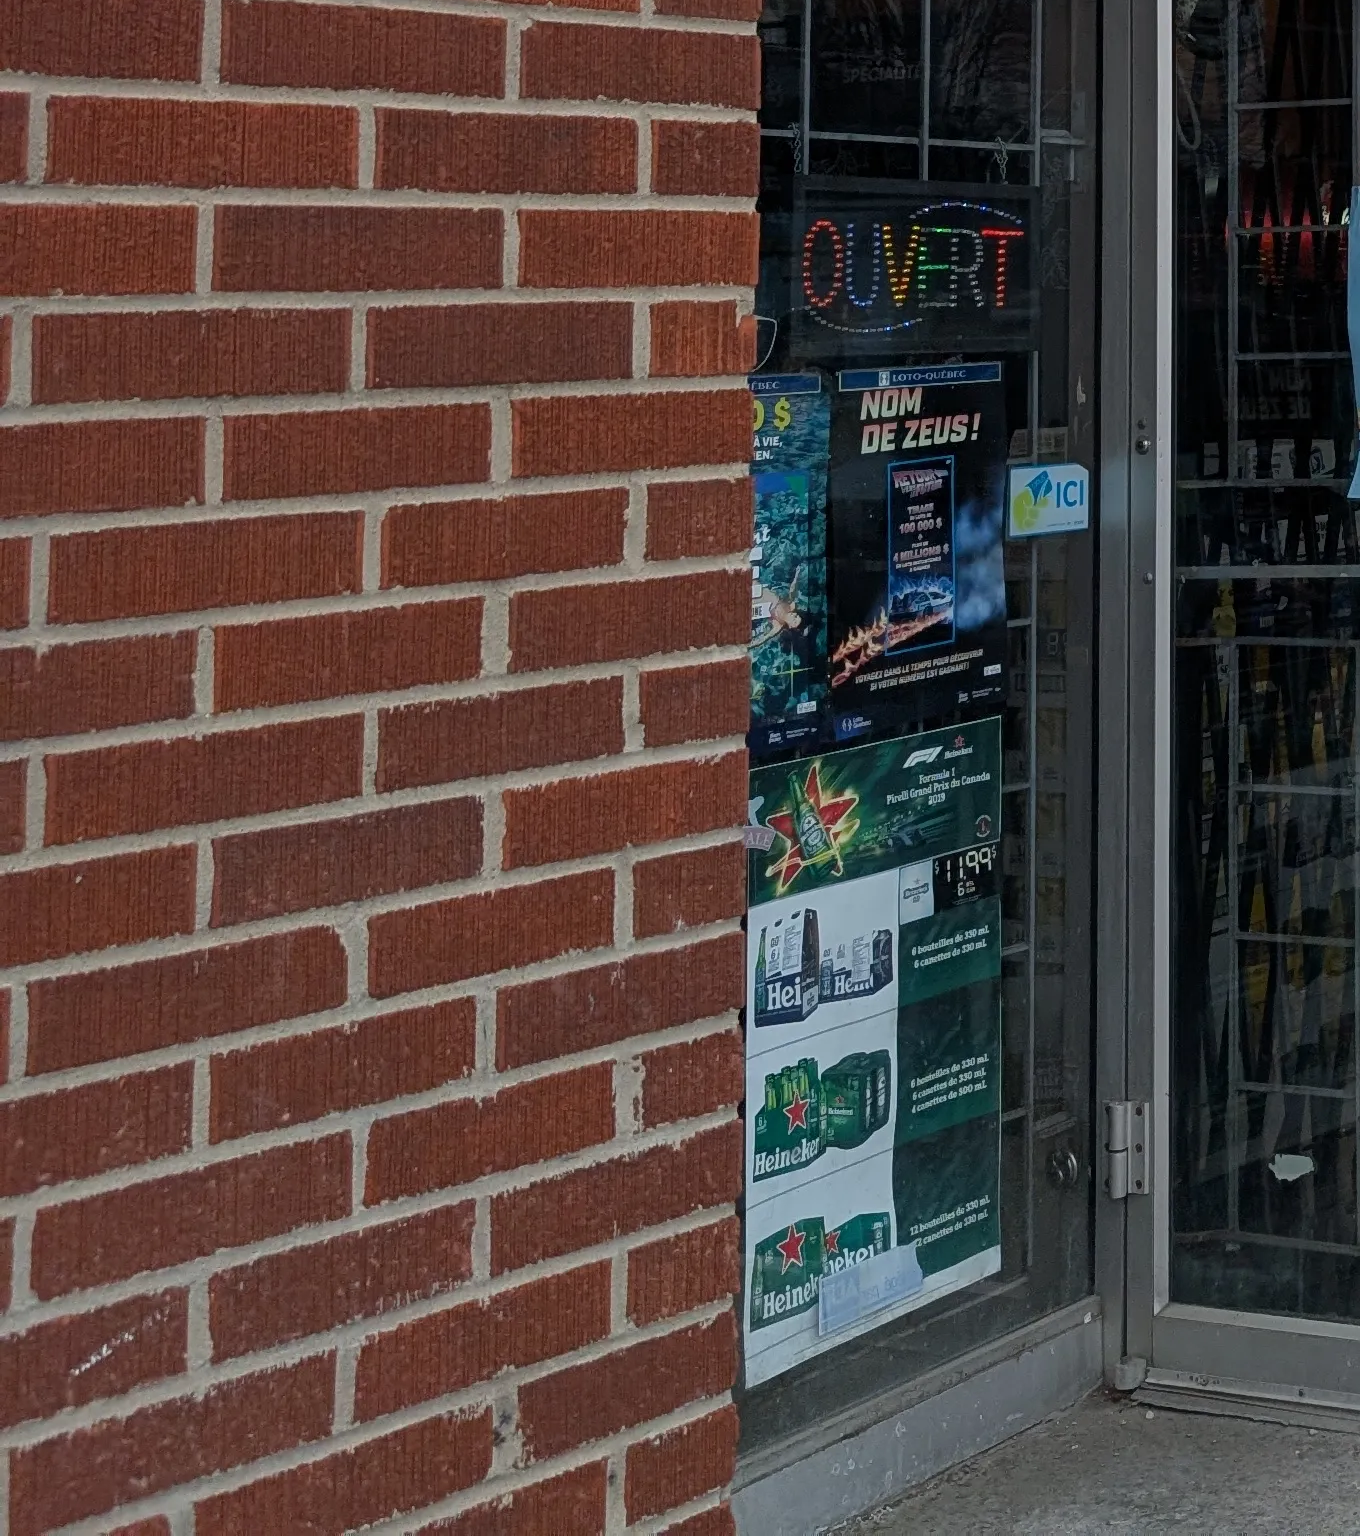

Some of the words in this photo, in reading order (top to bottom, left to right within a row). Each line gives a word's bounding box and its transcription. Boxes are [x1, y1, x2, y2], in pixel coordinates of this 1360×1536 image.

[803, 218, 1024, 308] OUVERT
[892, 369, 967, 382] LOTO-QUÉBEC
[860, 387, 923, 421] NOM
[861, 422, 897, 455] DE
[1056, 479, 1084, 509] ICI
[900, 544, 942, 561] MILLIONS
[886, 790, 909, 806] Pirelli
[910, 785, 932, 799] Grand
[933, 780, 949, 793] Prix
[951, 777, 960, 787] du
[961, 771, 991, 786] Canada
[919, 769, 951, 784] Formula
[928, 792, 946, 806] 2019
[957, 881, 965, 897] 6
[917, 934, 954, 954] bouteilles
[954, 932, 964, 943] de
[964, 928, 977, 940] 330
[978, 924, 990, 936] mL
[920, 950, 951, 967] canettes
[952, 947, 961, 957] de
[961, 941, 975, 954] 330
[975, 938, 987, 949] mL
[948, 1077, 958, 1087] de
[974, 1067, 987, 1078] mL
[951, 1063, 961, 1073] de
[977, 1053, 990, 1064] mL
[948, 1090, 958, 1100] de
[974, 1080, 987, 1091] mL
[919, 1212, 955, 1232] bouteilles
[956, 1207, 965, 1217] de
[966, 1201, 979, 1214] 330
[979, 1195, 990, 1209] mL
[923, 1225, 954, 1245] canettes
[954, 1221, 963, 1231] de
[977, 1209, 988, 1222] mL
